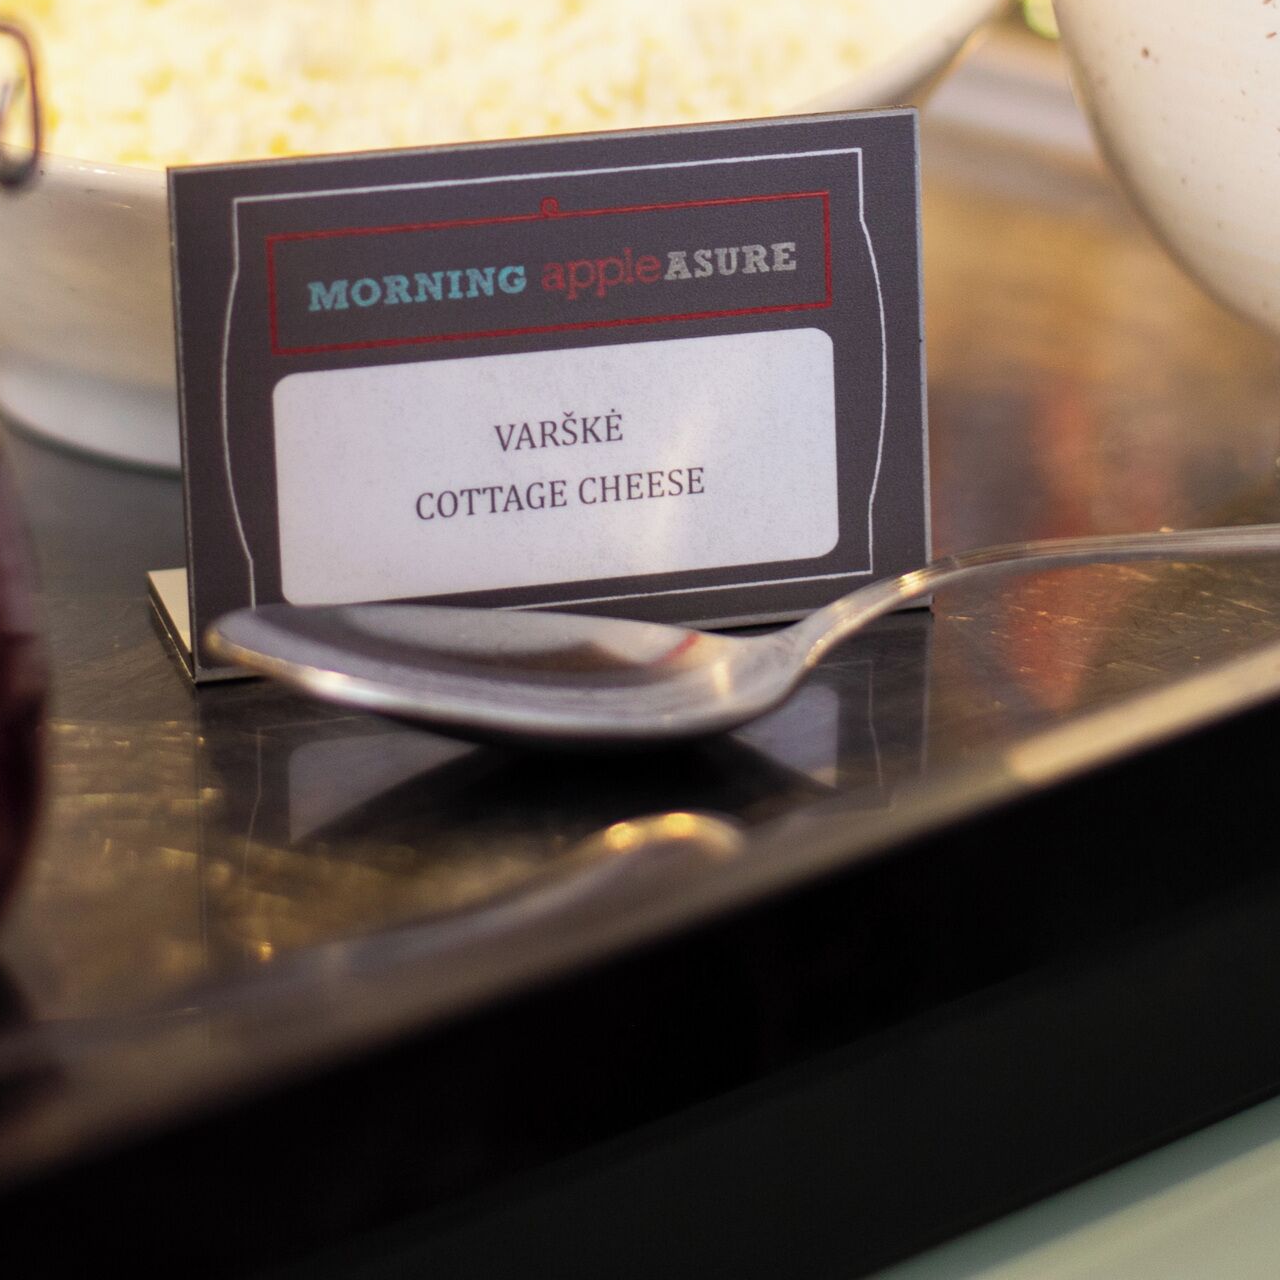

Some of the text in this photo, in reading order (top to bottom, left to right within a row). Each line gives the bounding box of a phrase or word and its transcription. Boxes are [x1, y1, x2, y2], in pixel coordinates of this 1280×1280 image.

[307, 265, 527, 311] MORNING
[494, 408, 624, 451] VARŠKĖ
[416, 466, 706, 520] COTTAGE CHEESE
